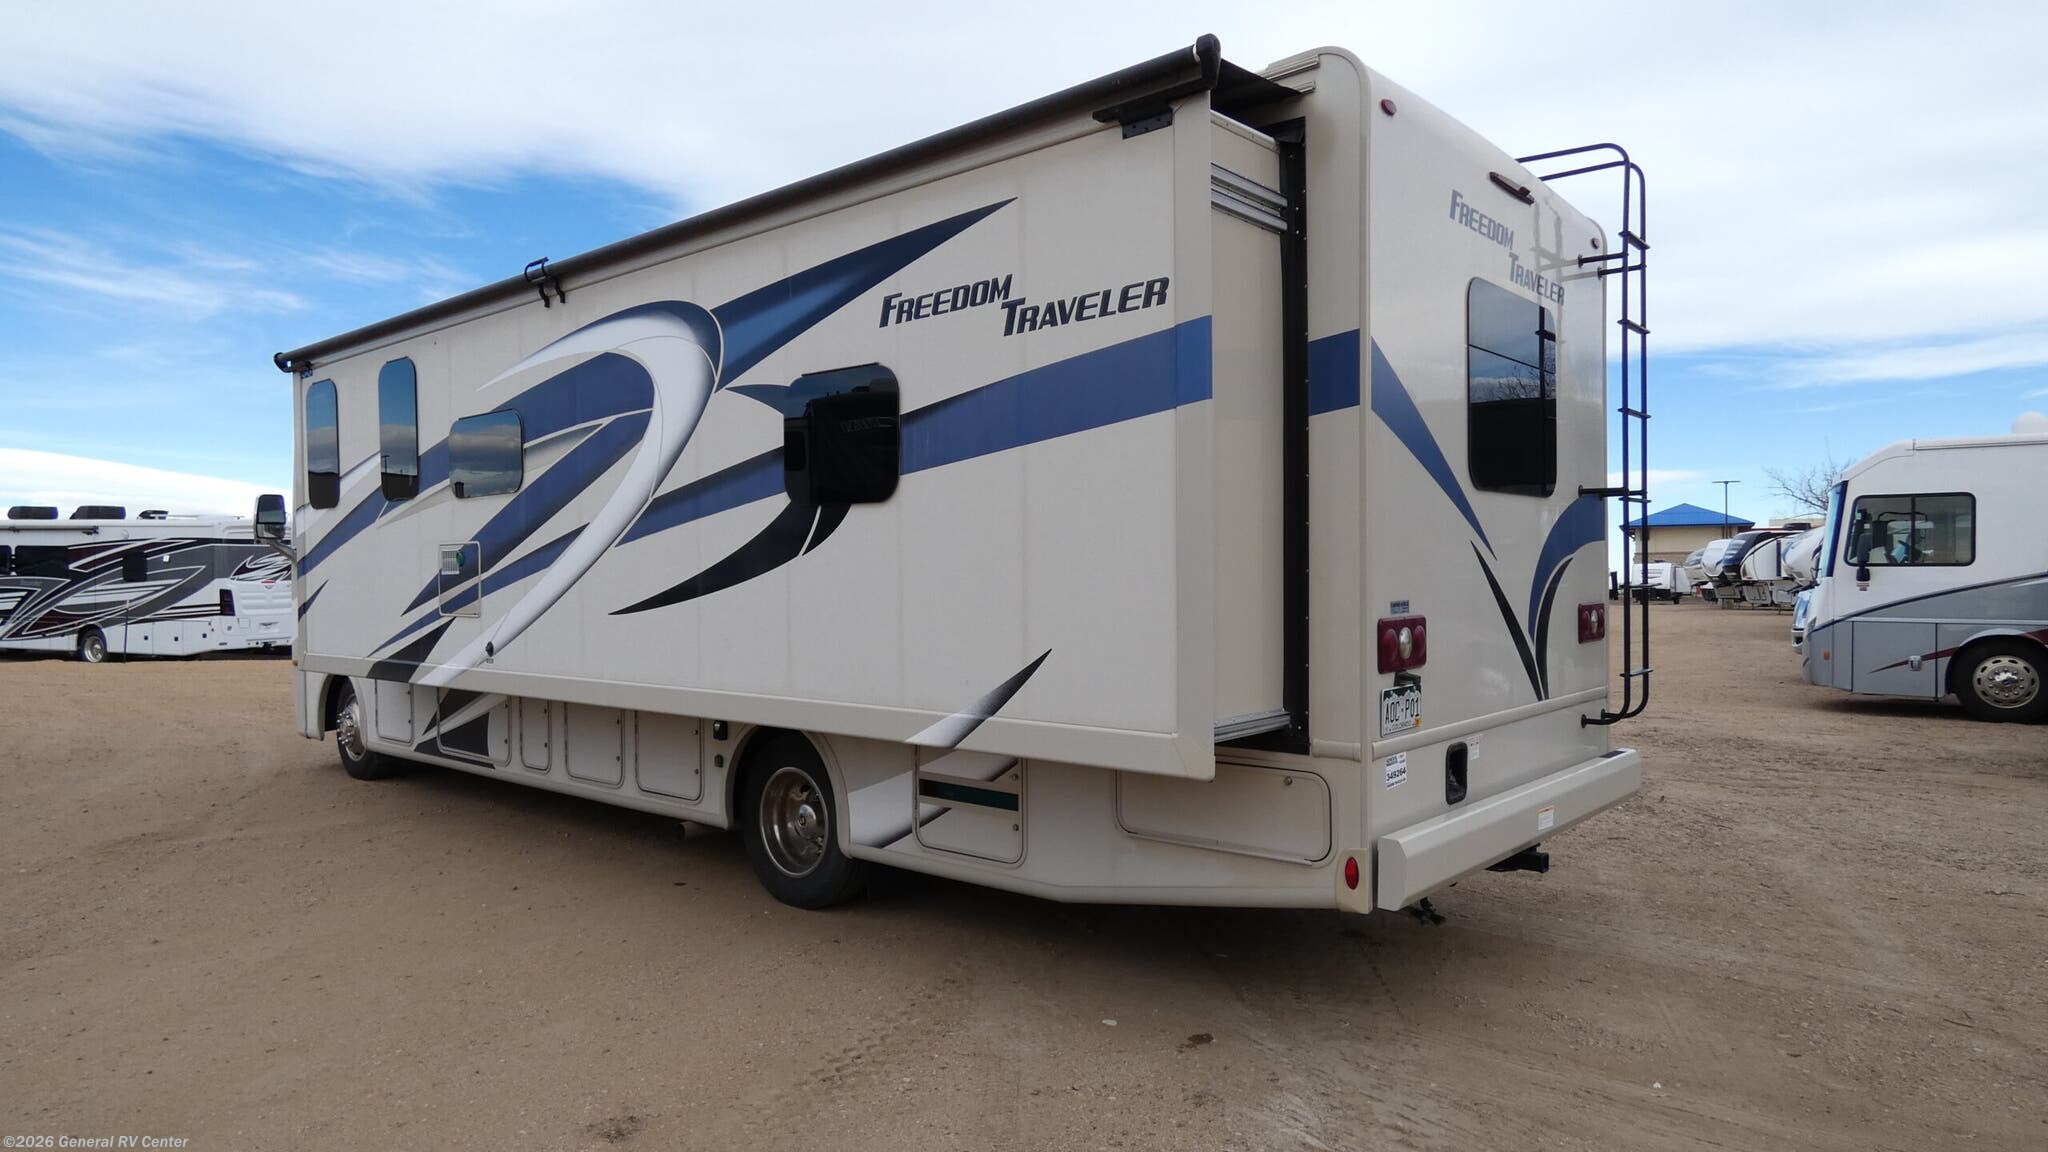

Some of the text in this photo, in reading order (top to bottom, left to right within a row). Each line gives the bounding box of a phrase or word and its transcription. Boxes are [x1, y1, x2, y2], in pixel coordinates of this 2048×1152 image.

[1449, 189, 1515, 251] FREEDOM
[879, 273, 1014, 328] FREEDOM
[1000, 276, 1170, 337] TRAVELER
[1508, 251, 1565, 306] TRAVELER
